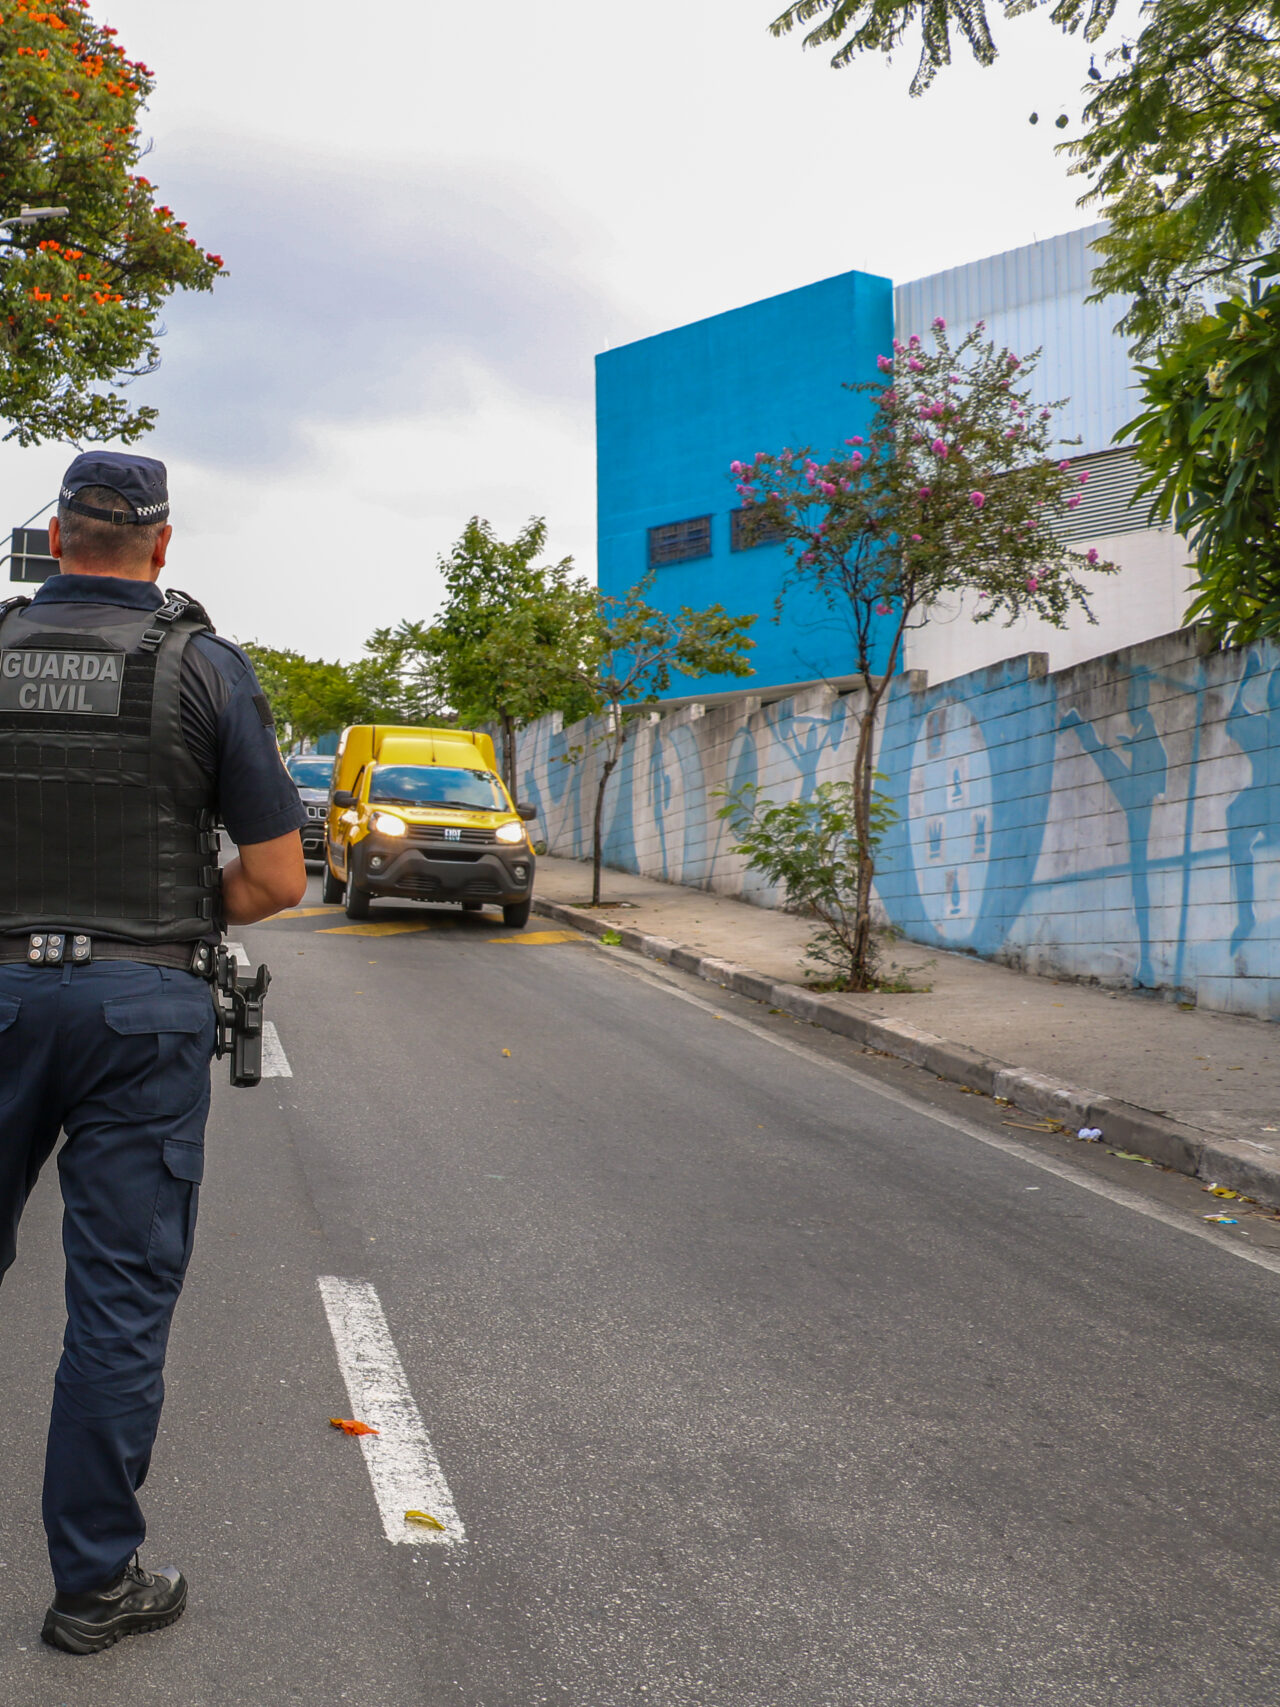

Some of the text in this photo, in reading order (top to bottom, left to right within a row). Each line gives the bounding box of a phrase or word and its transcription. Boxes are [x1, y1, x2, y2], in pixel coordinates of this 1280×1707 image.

[2, 652, 119, 682] GUARDA
[18, 682, 93, 712] CIVIL
[444, 828, 462, 841] FIAT
